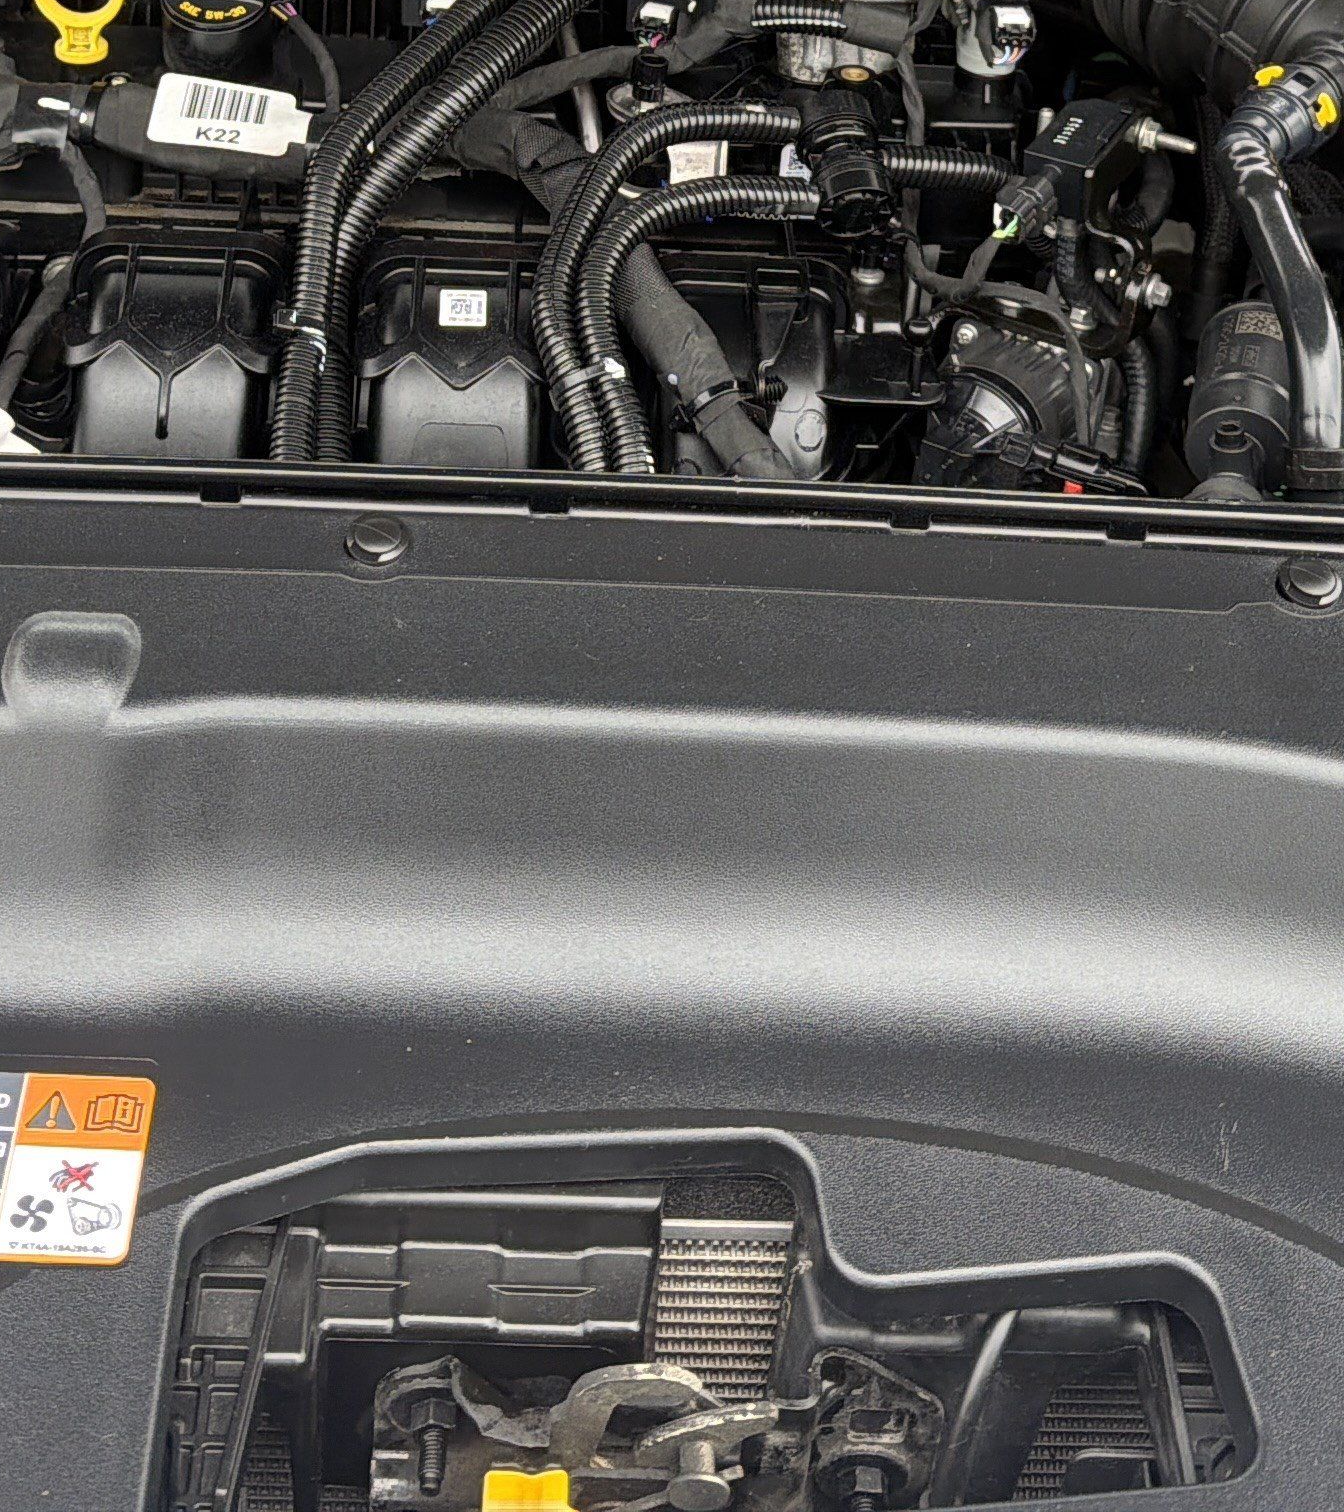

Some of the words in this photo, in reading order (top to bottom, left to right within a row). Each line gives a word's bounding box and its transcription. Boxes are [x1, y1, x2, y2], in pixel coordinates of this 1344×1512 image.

[179, 1, 202, 17] SAE
[205, 5, 247, 20] 5W-30
[195, 126, 241, 144] K22
